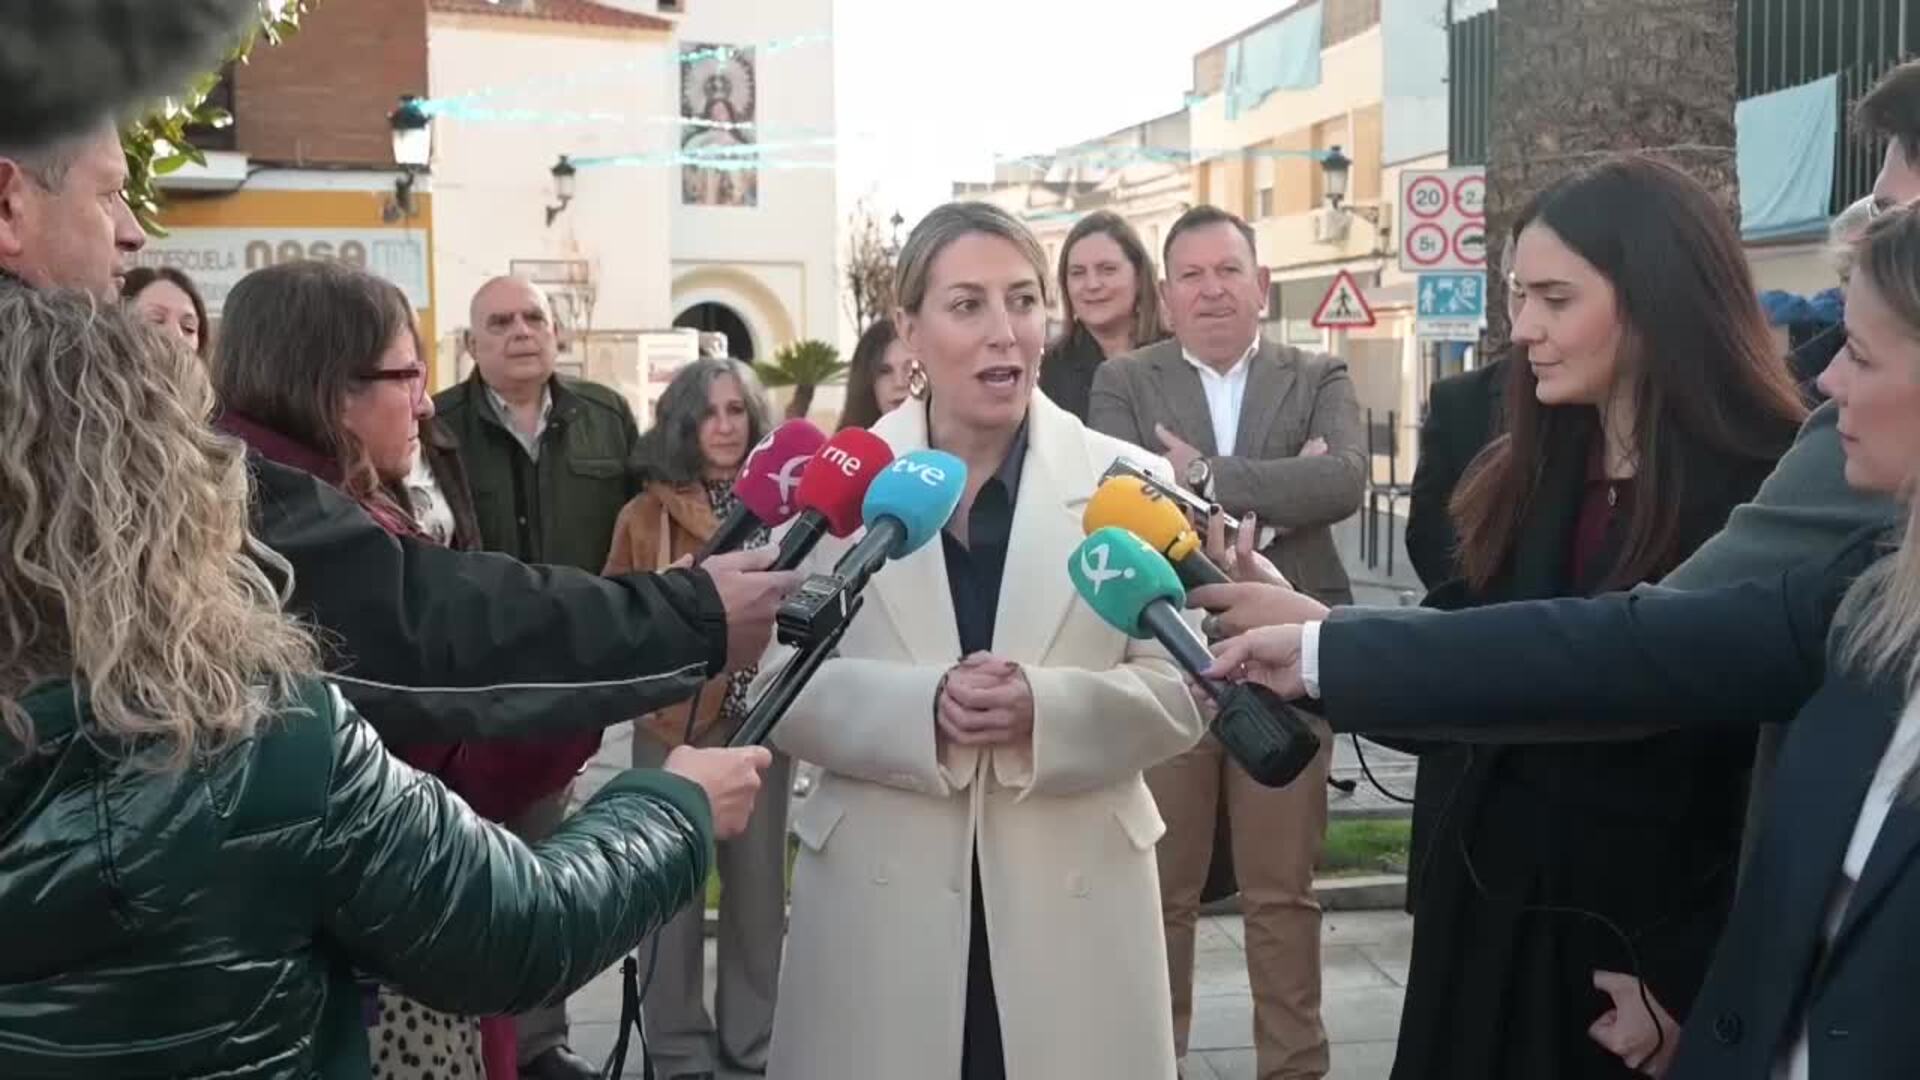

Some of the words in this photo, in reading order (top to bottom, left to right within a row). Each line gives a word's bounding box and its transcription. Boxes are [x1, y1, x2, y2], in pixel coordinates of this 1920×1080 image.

[1415, 189, 1440, 206] 20
[822, 445, 862, 477] rne
[891, 456, 946, 486] tve
